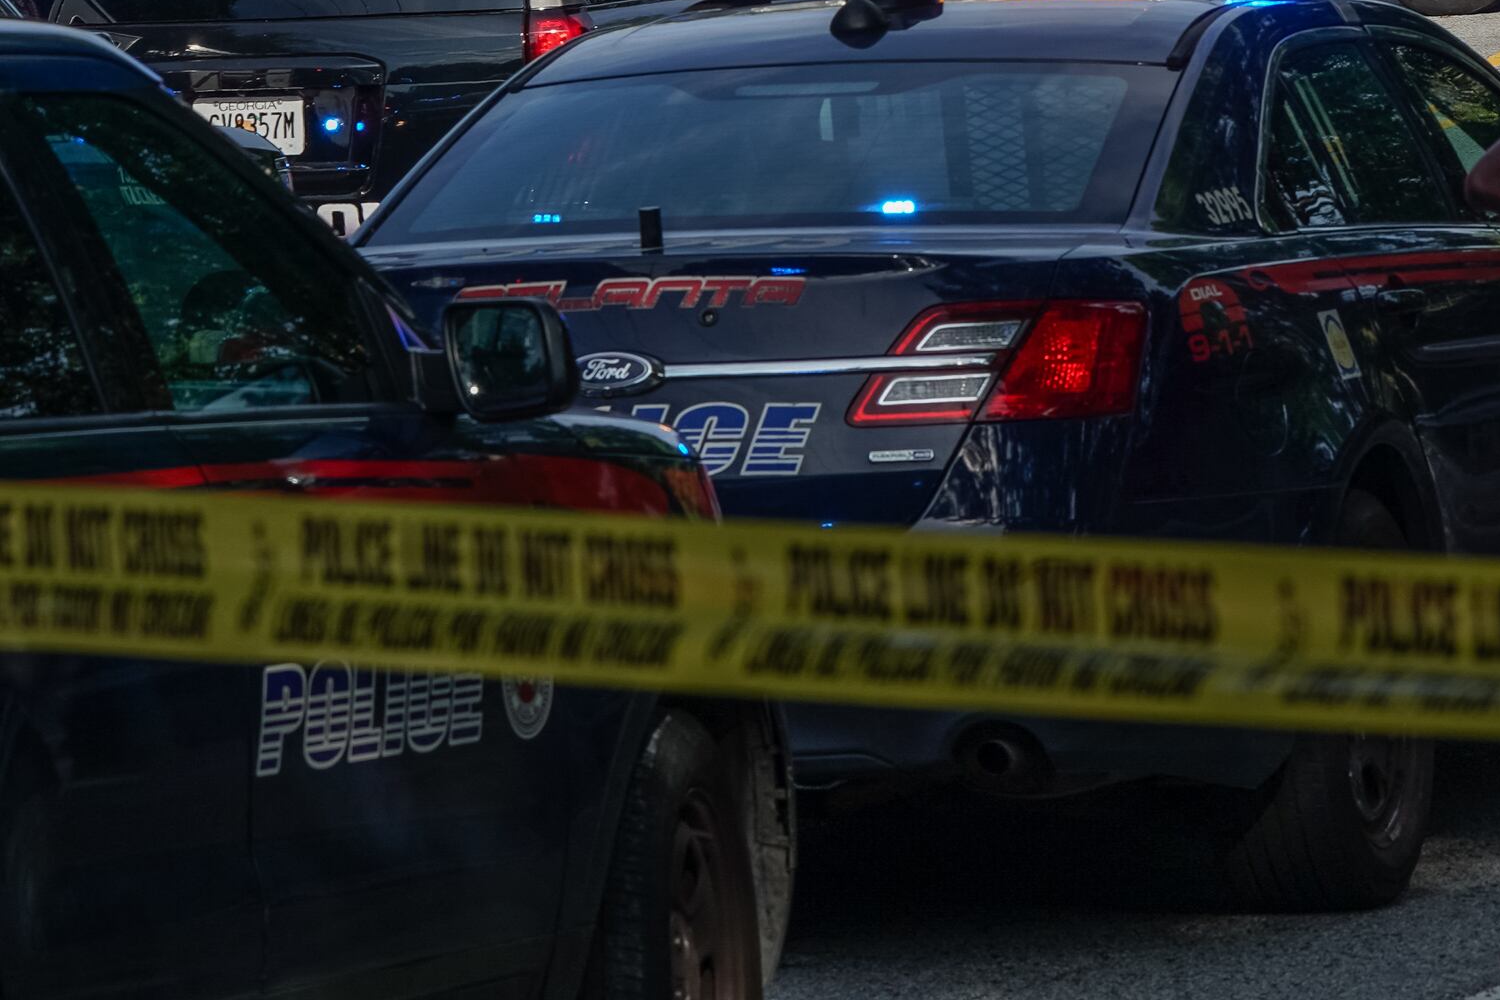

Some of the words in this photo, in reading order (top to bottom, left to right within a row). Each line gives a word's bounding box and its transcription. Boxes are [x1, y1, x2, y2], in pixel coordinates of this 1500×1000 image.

[217, 100, 278, 112] GEORGIA
[1190, 285, 1223, 301] DIAL
[1188, 323, 1253, 362] 9-1-1
[582, 358, 631, 381] Ford
